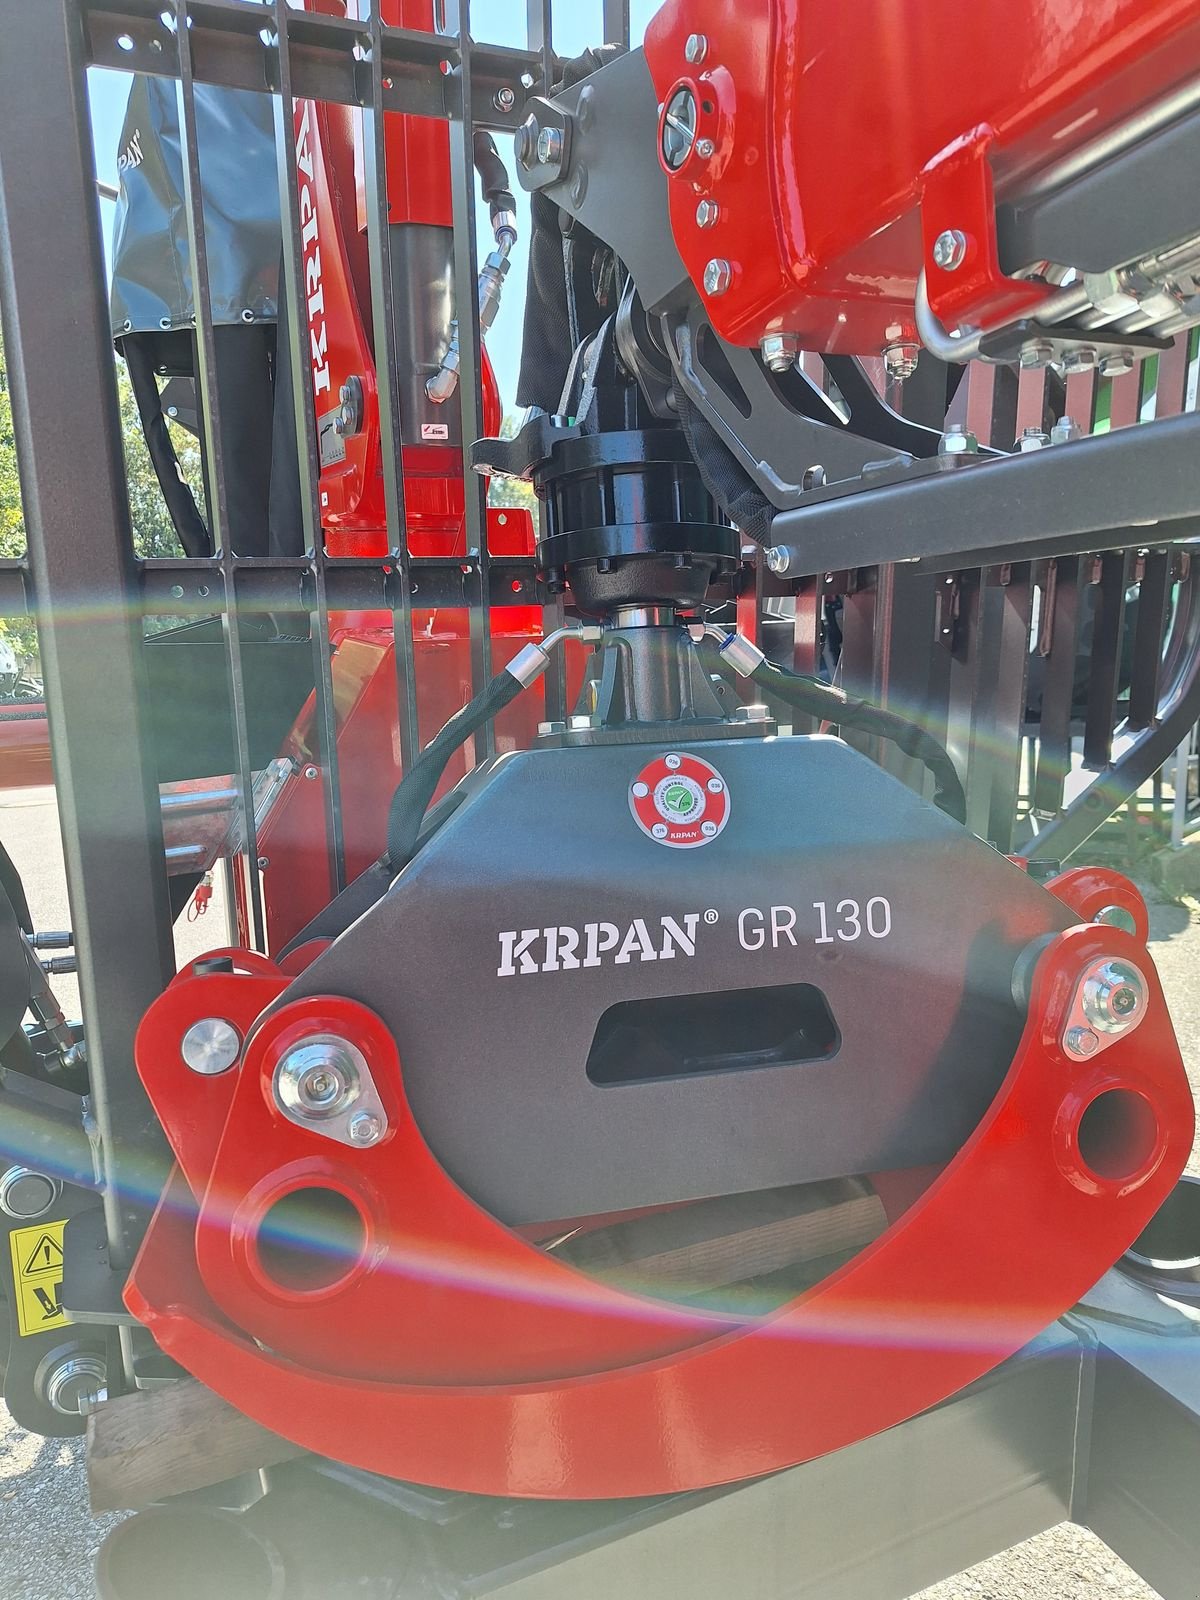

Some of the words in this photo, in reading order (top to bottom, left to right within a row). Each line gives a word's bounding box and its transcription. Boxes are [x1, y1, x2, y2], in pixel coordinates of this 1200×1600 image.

[292, 97, 331, 396] KRPA
[662, 781, 684, 792] CONTROL
[737, 904, 799, 951] GR
[812, 896, 892, 944] 130
